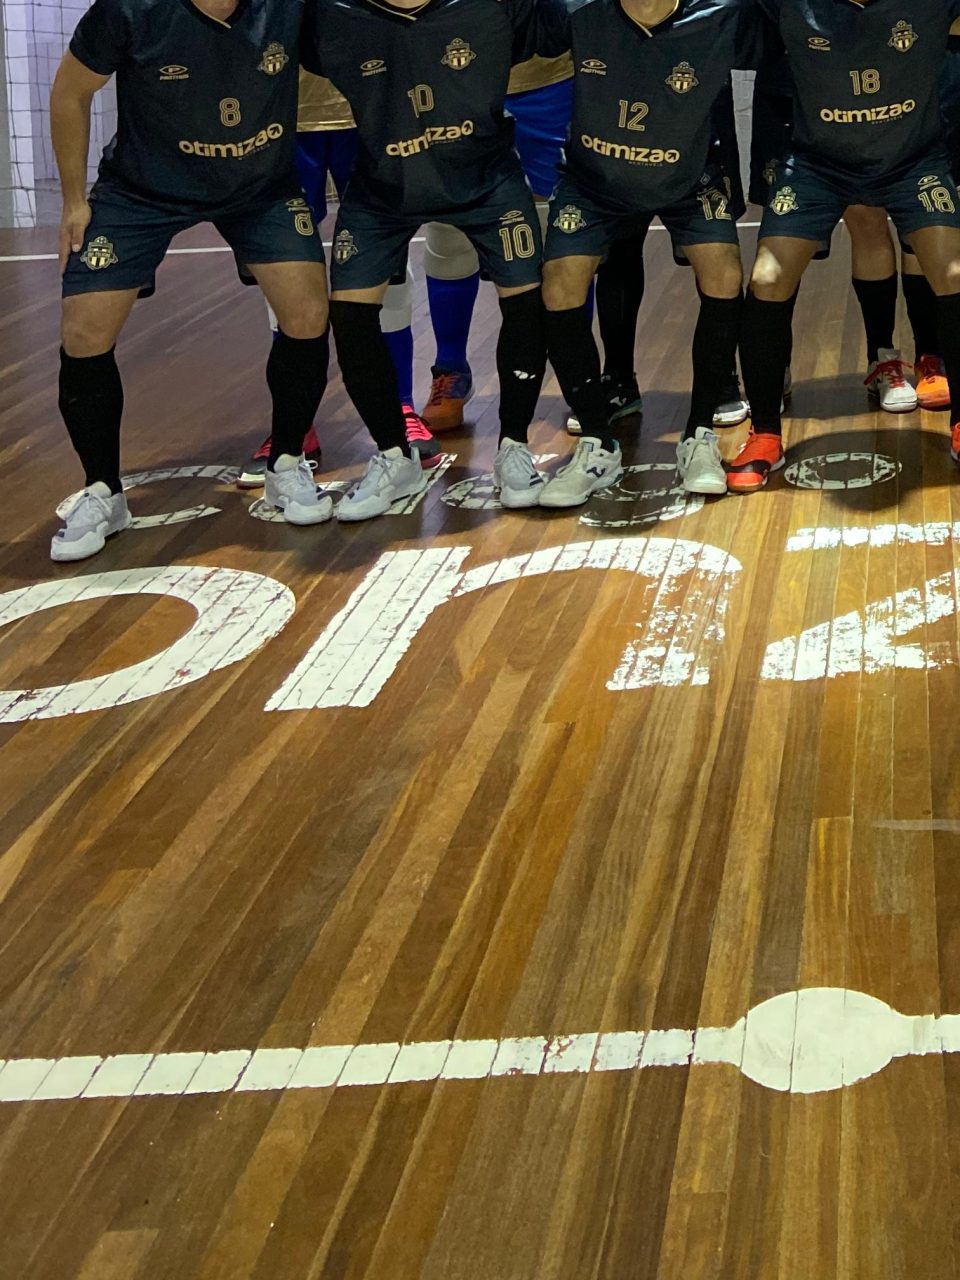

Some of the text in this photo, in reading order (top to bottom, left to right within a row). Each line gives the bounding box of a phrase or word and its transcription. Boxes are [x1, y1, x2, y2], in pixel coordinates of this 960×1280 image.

[849, 68, 881, 95] 18
[219, 97, 242, 127] 8
[407, 84, 435, 118] 10
[618, 99, 649, 131] 12
[697, 191, 732, 220] 12
[918, 186, 955, 214] 18
[499, 223, 535, 261] 10
